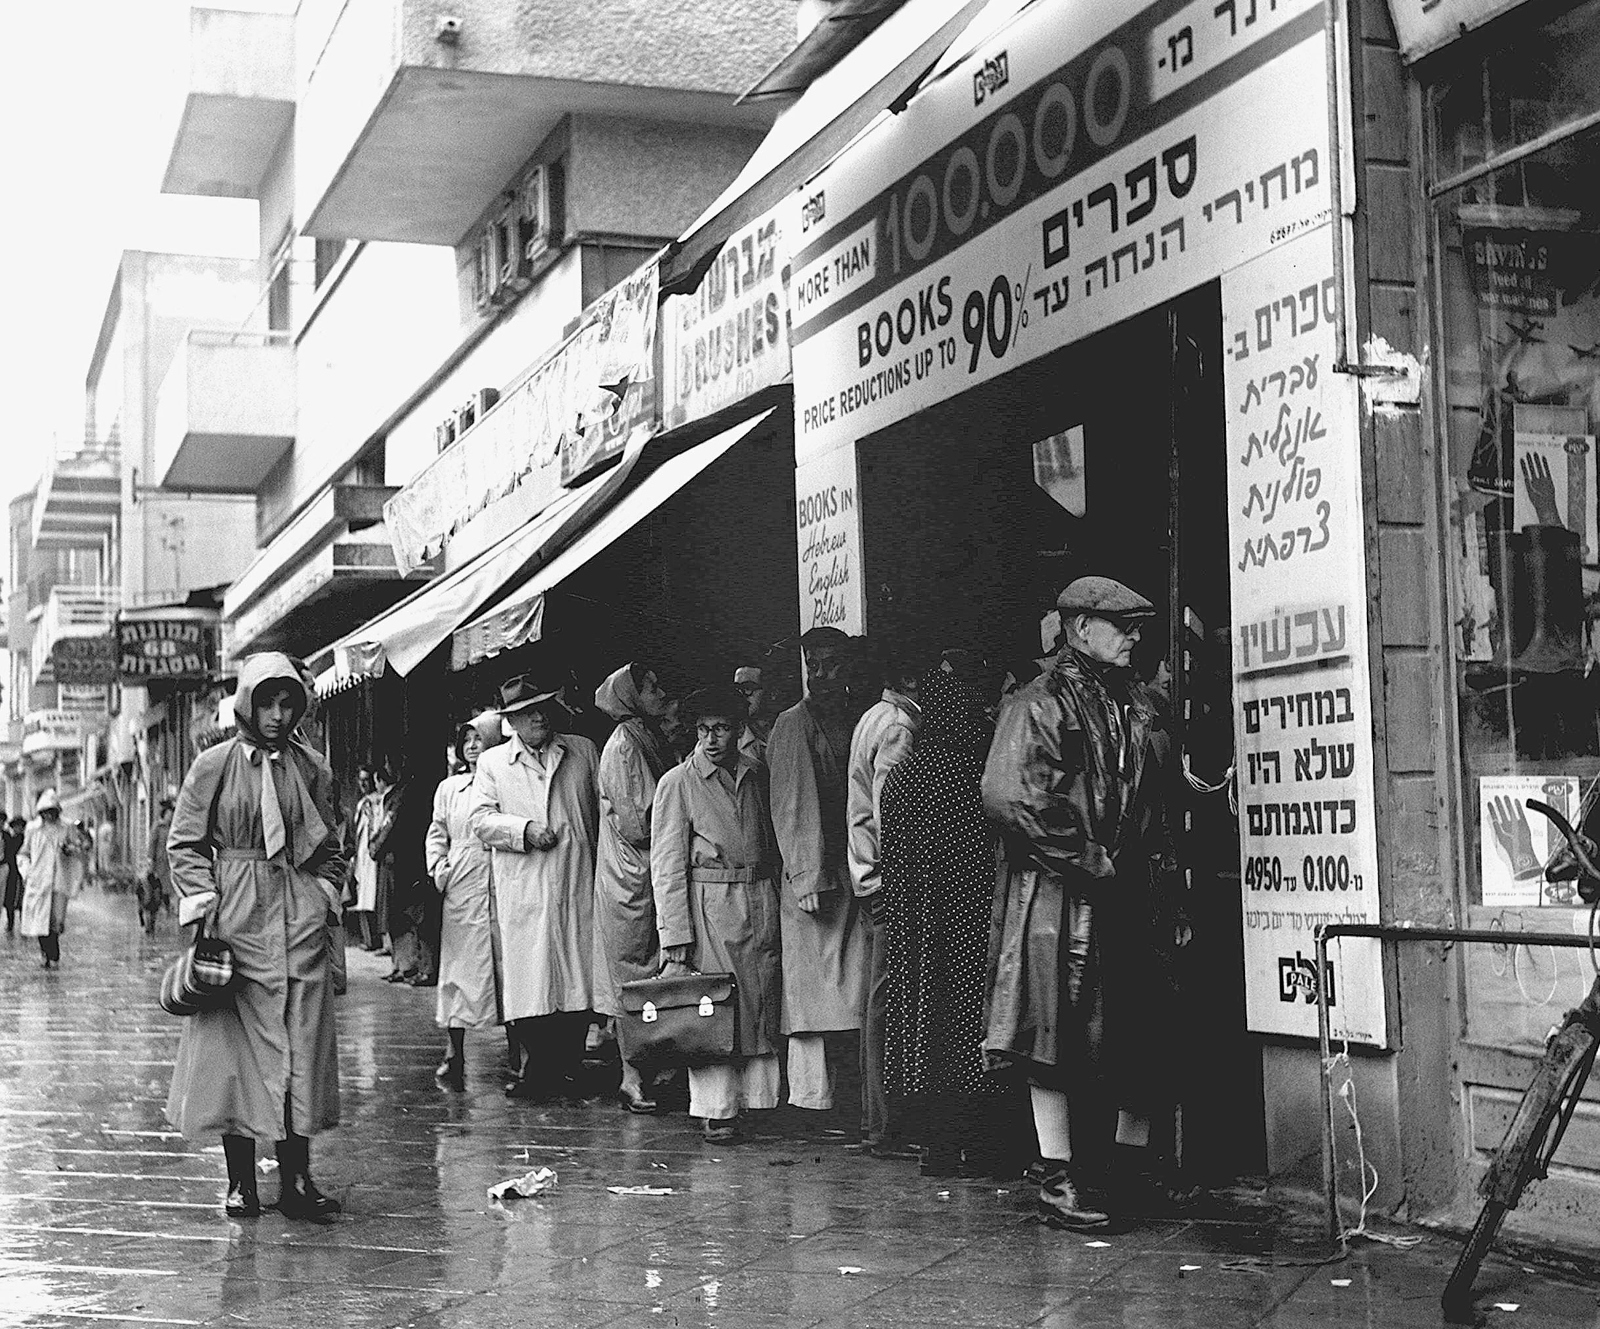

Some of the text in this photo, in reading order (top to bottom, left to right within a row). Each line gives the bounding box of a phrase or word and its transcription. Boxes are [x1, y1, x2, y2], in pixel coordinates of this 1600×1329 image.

[1033, 147, 1319, 317] מחירי הנחה עד
[1042, 134, 1197, 270] ספרים
[797, 265, 829, 311] MORE
[834, 238, 870, 286] THAN
[857, 275, 953, 368] BOOKS
[1254, 276, 1336, 353] ספרים
[804, 262, 1032, 434] PRICE REDUCTIONS UP TO 90%
[1239, 353, 1320, 415] עברית
[1240, 403, 1327, 467] אנגלית
[799, 485, 853, 529] BOOKS IN
[1242, 455, 1322, 525] פולנית
[802, 523, 846, 563] Hebrew
[1238, 500, 1331, 573] צרפתית
[808, 553, 850, 604] English
[812, 594, 847, 628] Polish
[1240, 604, 1346, 668] עכשיו
[1243, 687, 1355, 734] במחירים
[1248, 738, 1355, 785] שלא היו
[1247, 799, 1357, 837] כדוגמתם
[1245, 855, 1282, 892] 4950
[1283, 876, 1297, 892] עד
[1290, 973, 1317, 991] PALE
